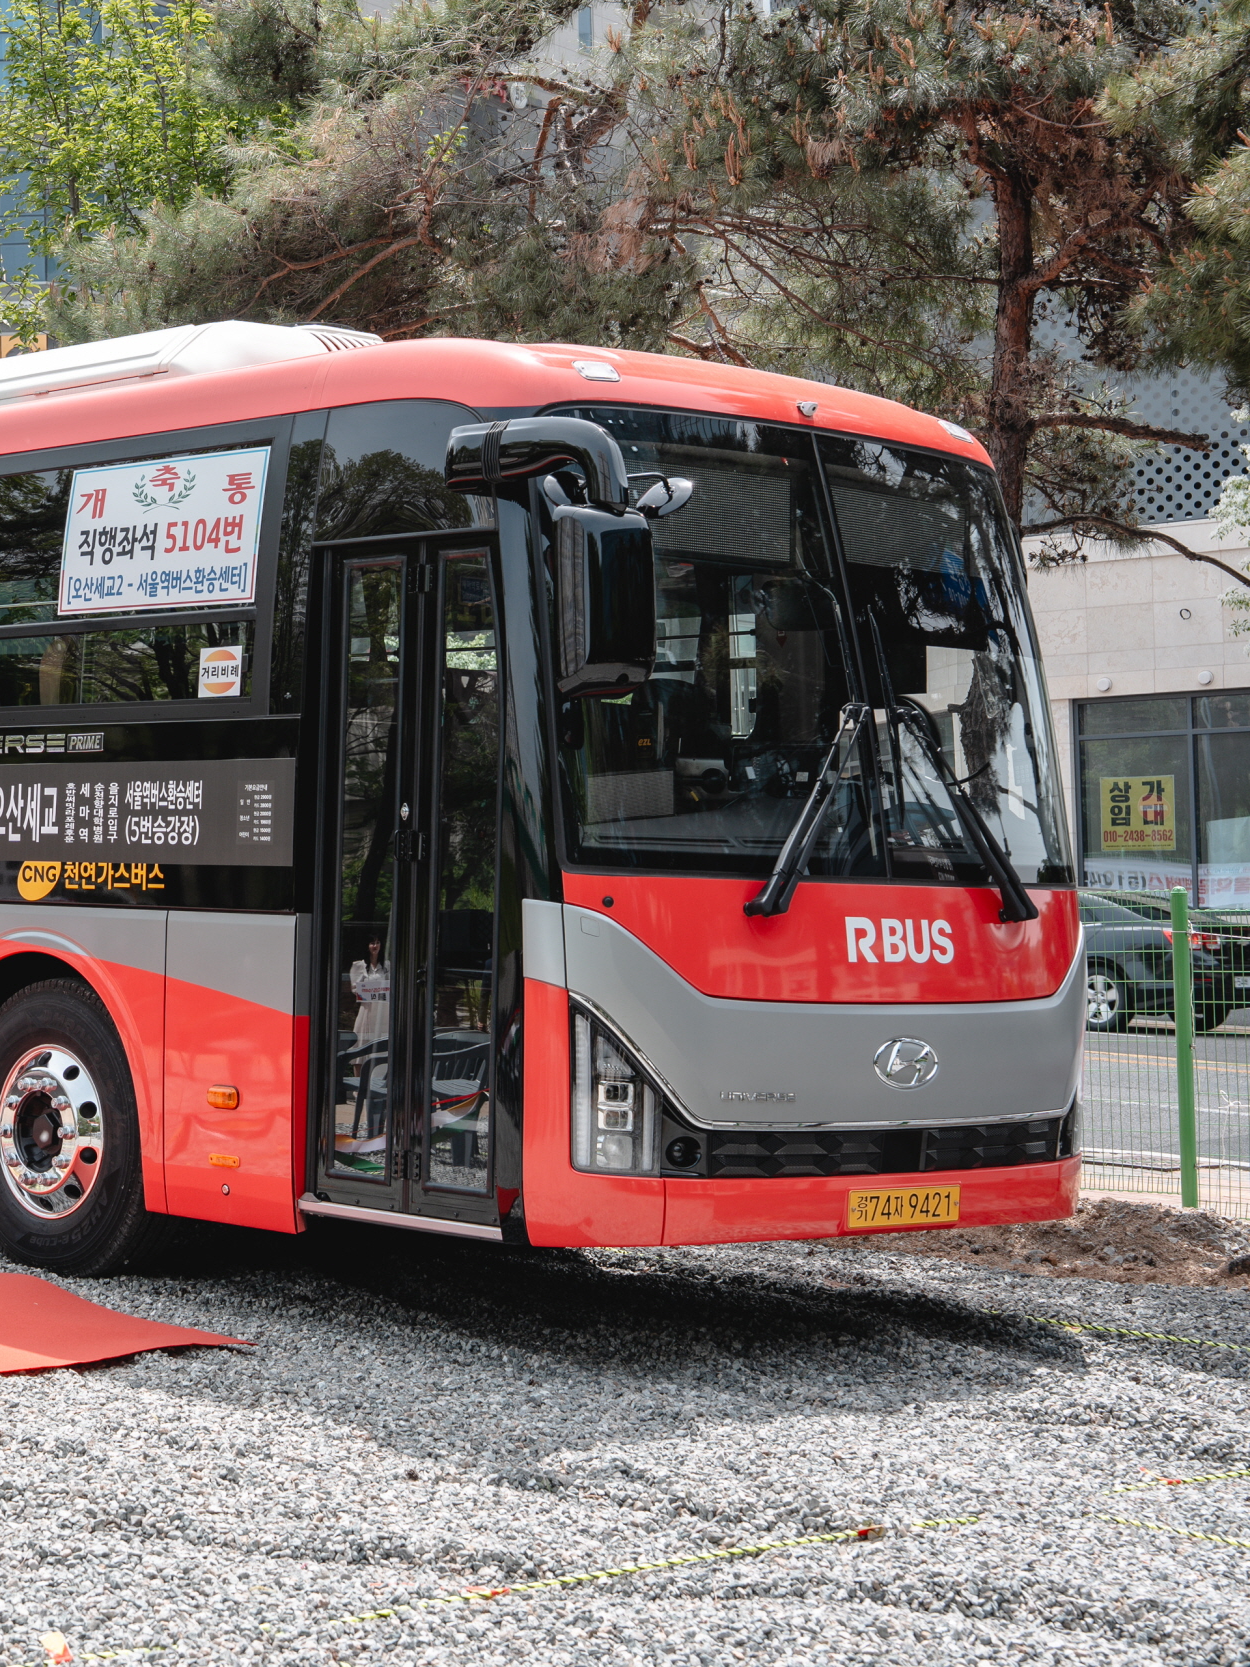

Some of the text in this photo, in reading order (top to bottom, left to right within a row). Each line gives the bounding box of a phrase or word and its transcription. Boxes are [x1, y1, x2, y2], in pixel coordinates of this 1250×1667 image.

[149, 464, 181, 492] 축
[76, 472, 256, 519] 개 통
[78, 514, 244, 566] 직행좌석 5104번
[200, 664, 240, 680] 거리비례
[69, 734, 102, 751] PRIME
[125, 780, 203, 811] 서울역버스환승센터
[79, 783, 90, 843] 세마역
[107, 783, 119, 843] 을지로입구
[125, 815, 200, 846] (5번승강장)
[1103, 830, 1173, 842] 010-2438-8562
[22, 865, 59, 883] CNG
[64, 861, 164, 890] 천연가스버스
[720, 1091, 797, 1102] UNIVERSE
[908, 1191, 951, 1219] 9421
